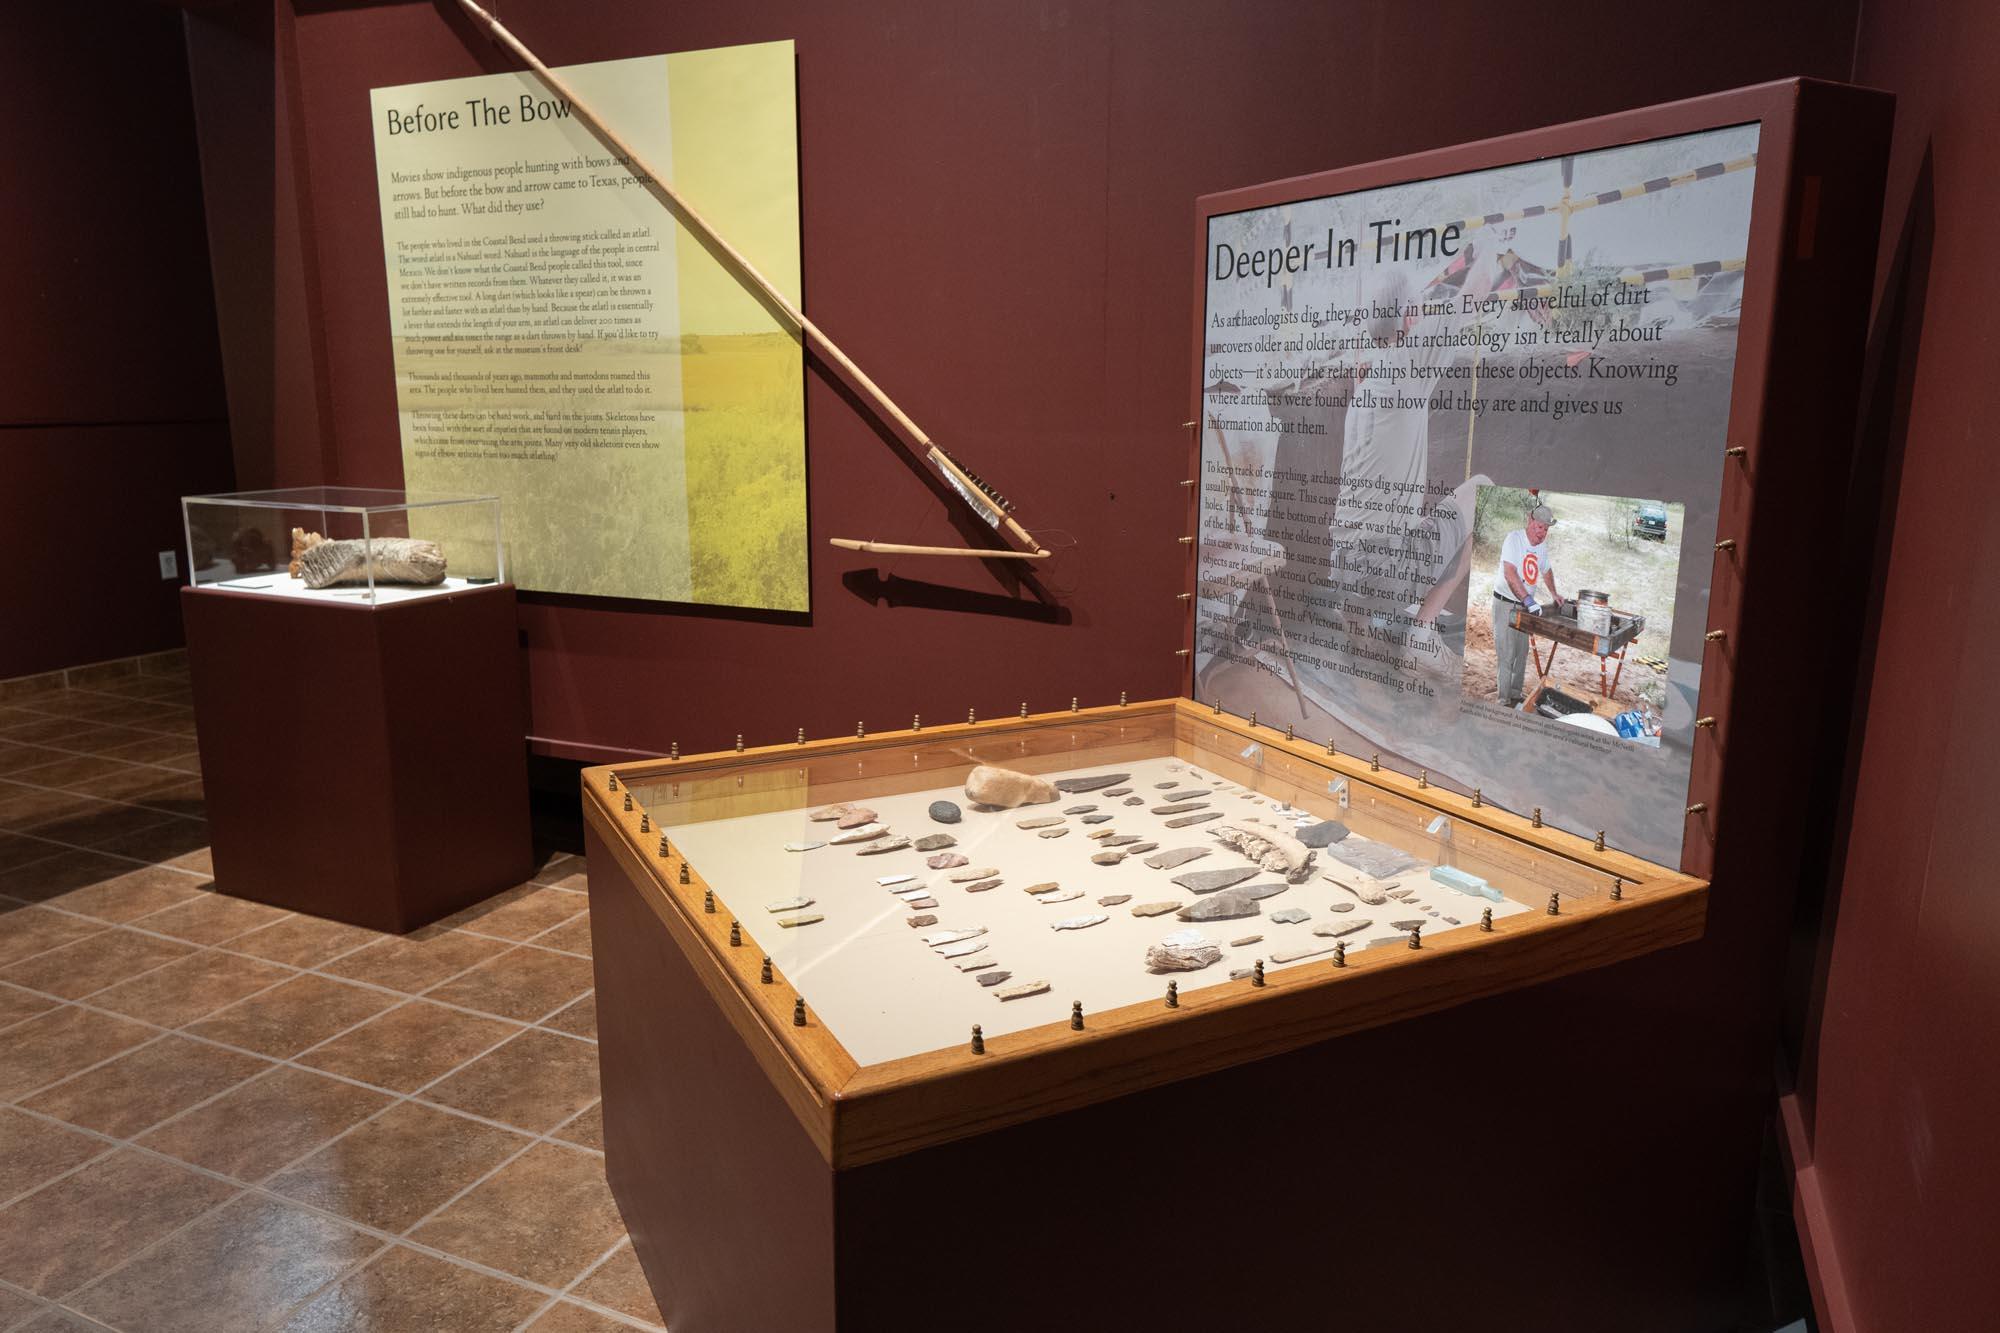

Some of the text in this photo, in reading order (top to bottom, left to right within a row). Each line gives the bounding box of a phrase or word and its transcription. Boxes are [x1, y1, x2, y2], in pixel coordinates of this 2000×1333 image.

[388, 95, 572, 135] Before The Bow
[391, 152, 630, 184] Movies show indigenous people hunting with bows and
[424, 187, 439, 199] But
[440, 184, 468, 198] before
[469, 183, 483, 196] the
[485, 182, 505, 195] bow
[506, 180, 522, 194] and
[524, 182, 550, 193] arrow
[553, 181, 576, 191] came
[578, 178, 588, 189] to
[589, 176, 619, 188] Texas,
[622, 171, 653, 190] people
[394, 205, 410, 219] still
[410, 204, 426, 218] had
[428, 207, 437, 217] to
[460, 201, 486, 215] What
[487, 199, 503, 213] did
[504, 198, 523, 215] they
[526, 196, 545, 211] use?
[600, 229, 621, 240] called
[602, 243, 625, 257] people
[635, 241, 660, 252] central
[593, 259, 607, 269] this
[1215, 220, 1459, 287] Deeper In Time
[1211, 283, 1651, 330] As archaeologists dig, they go back in time. Every shovelful of dirt
[1210, 320, 1663, 353] uncovers older and older artifacts. But archaeology isn't really about
[1274, 362, 1304, 379] about
[1307, 361, 1325, 379] the
[1327, 361, 1407, 385] relationships
[1410, 360, 1470, 379] between
[1475, 359, 1514, 379] these
[1519, 359, 1581, 385] objects.
[1588, 359, 1679, 385] Knowing
[1208, 388, 1623, 419] where artifacts were found tells us how old they are and gives us
[1208, 413, 1328, 435] information about them.
[1206, 461, 1457, 498] To of archaeologists dig square holes,
[1298, 489, 1457, 520] This case is the size of one of those
[1271, 506, 1441, 541] the bottom of case was the bottom
[1250, 541, 1437, 586] found small but all of these
[1295, 529, 1444, 567] oldest Not everything in
[1308, 571, 1425, 606] County and rest of the
[1344, 598, 1447, 634] from single the
[1309, 630, 1418, 671] decade of archaeological
[1347, 620, 1442, 659] The McNeill family
[1322, 659, 1434, 697] our understanding of the
